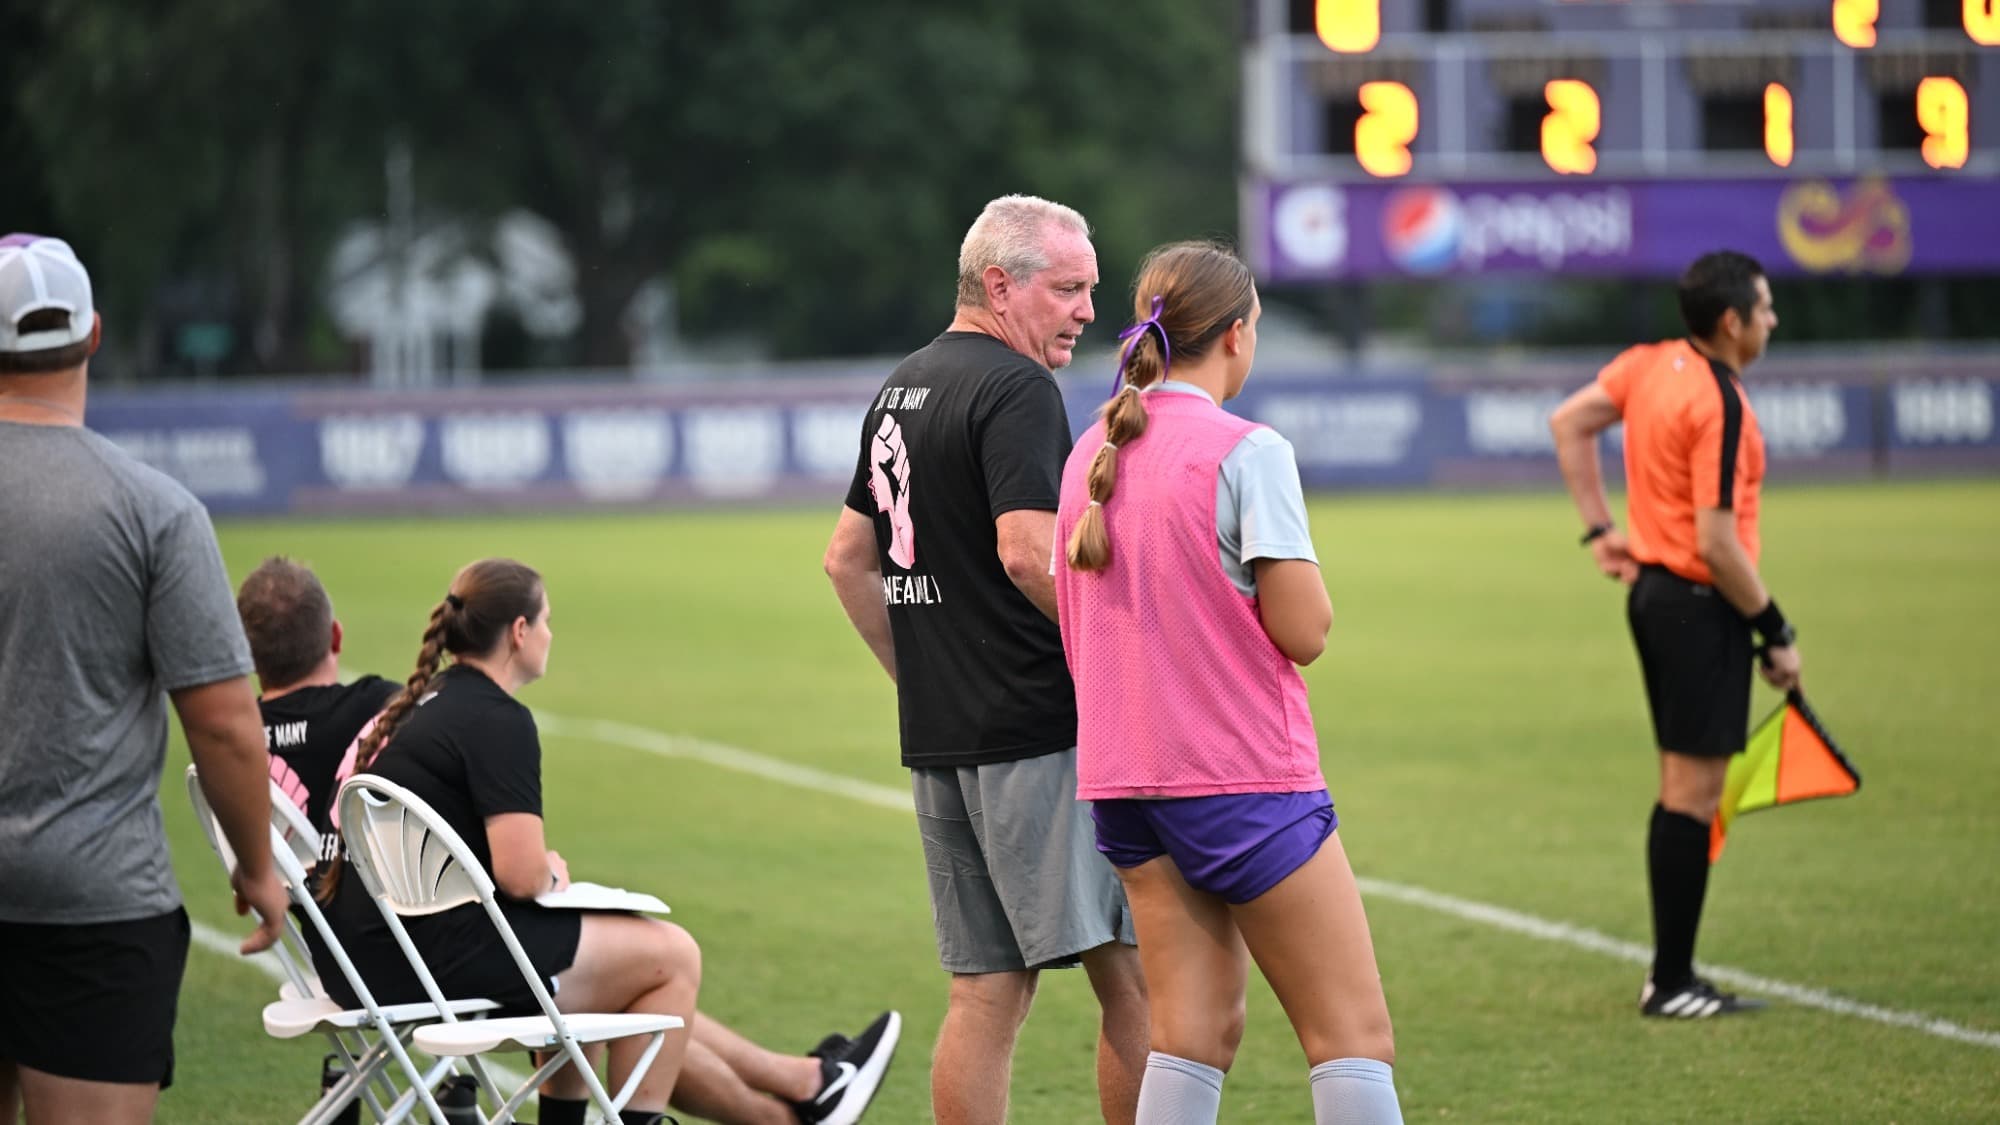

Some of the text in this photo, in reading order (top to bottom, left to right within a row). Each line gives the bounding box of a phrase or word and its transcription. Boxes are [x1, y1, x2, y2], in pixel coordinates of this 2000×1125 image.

[1764, 82, 1793, 167] 1
[1917, 76, 1969, 169] 9
[900, 387, 931, 410] MANY
[275, 720, 308, 748] MANY
